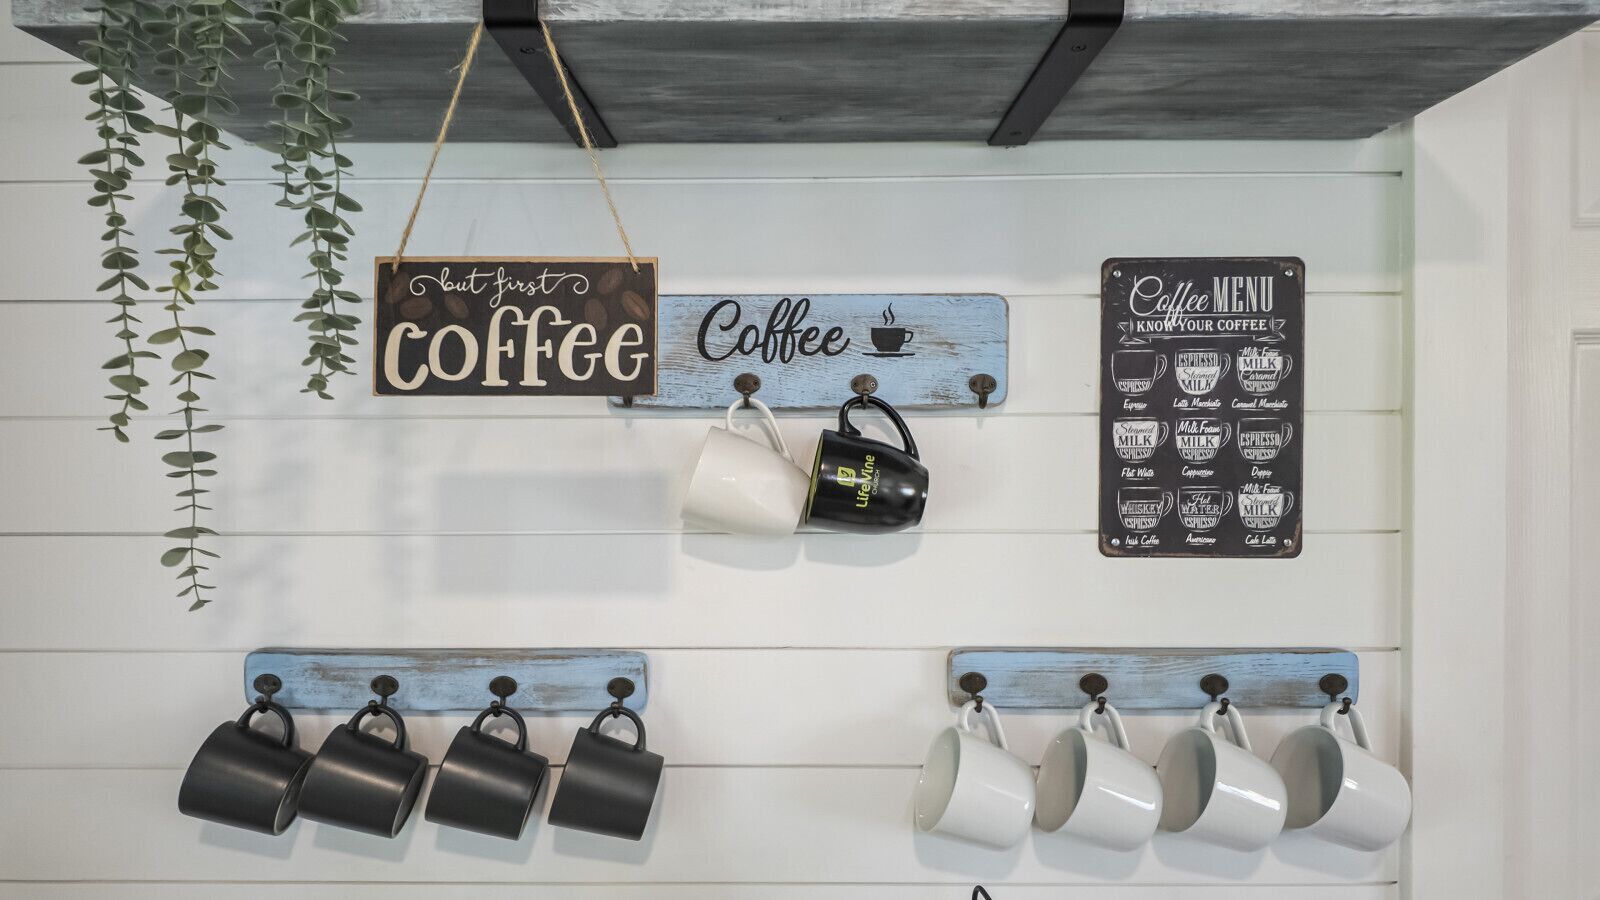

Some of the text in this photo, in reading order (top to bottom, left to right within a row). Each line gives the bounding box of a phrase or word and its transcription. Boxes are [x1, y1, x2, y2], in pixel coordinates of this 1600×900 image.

[410, 266, 589, 308] but first
[1129, 275, 1274, 327] Coffee MENU
[697, 297, 850, 364] Coffee
[1136, 319, 1267, 333] KNOW YOUR COFFEE
[1178, 352, 1219, 367] ESPRESSO
[1243, 358, 1277, 369] MILK
[1118, 380, 1151, 393] ESPRESSO
[1180, 379, 1212, 391] MILK
[1177, 420, 1220, 433] Milk Foam
[1118, 434, 1152, 446] MILK
[1181, 436, 1214, 448] MILK
[1240, 432, 1280, 447] ESPRESSO
[1181, 448, 1215, 461] ESPRESSO
[1243, 448, 1277, 461] ESPRESSO
[871, 469, 880, 495] CHURCH
[1120, 501, 1163, 515] WHISKEY
[1180, 504, 1221, 515] WATER
[1243, 504, 1278, 516] MILK
[1124, 517, 1157, 530] ESPRESSO
[1184, 517, 1218, 529] ESPRESSO
